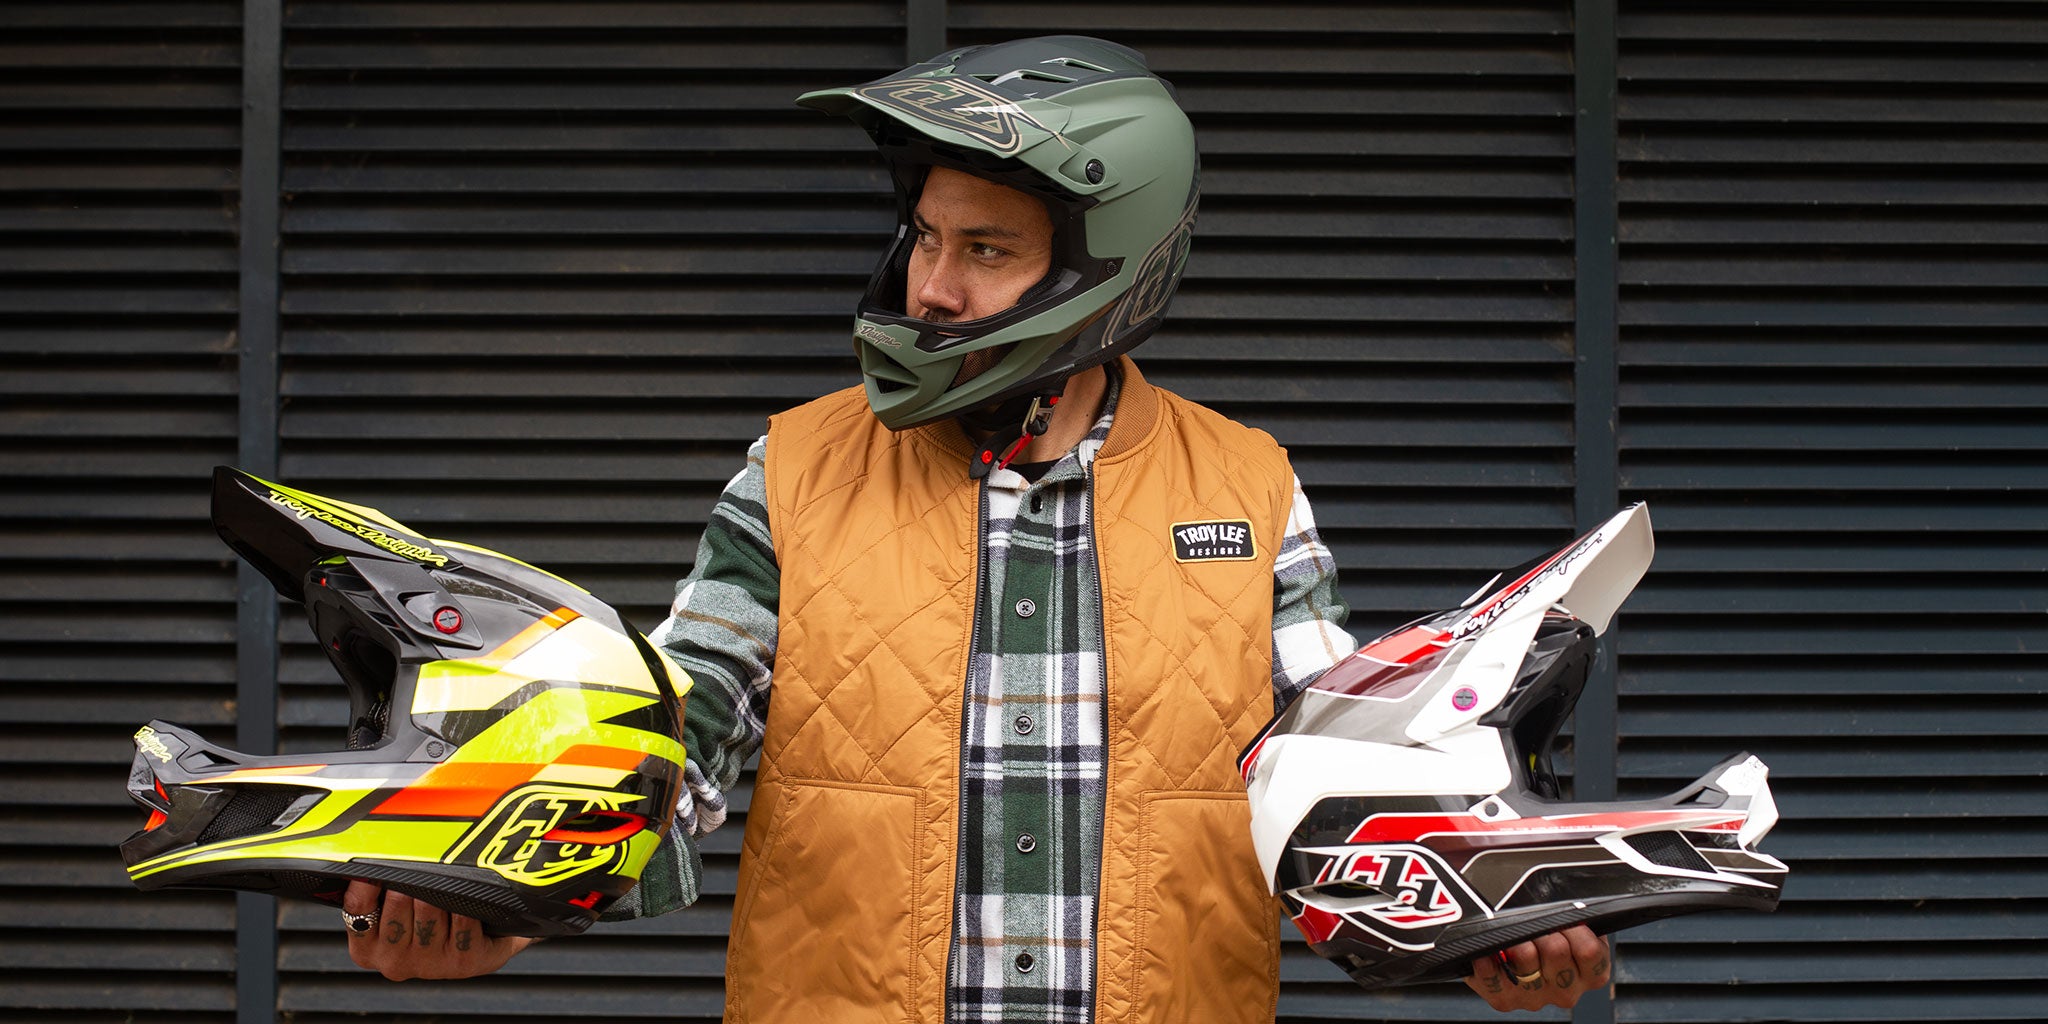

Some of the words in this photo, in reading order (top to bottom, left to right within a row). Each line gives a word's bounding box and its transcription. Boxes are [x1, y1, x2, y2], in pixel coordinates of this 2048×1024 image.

[355, 525, 449, 567] Designs
[1176, 525, 1217, 545] TROY
[1219, 524, 1247, 544] LEE
[1189, 545, 1241, 556] DESIGNS
[1448, 612, 1490, 639] Troy
